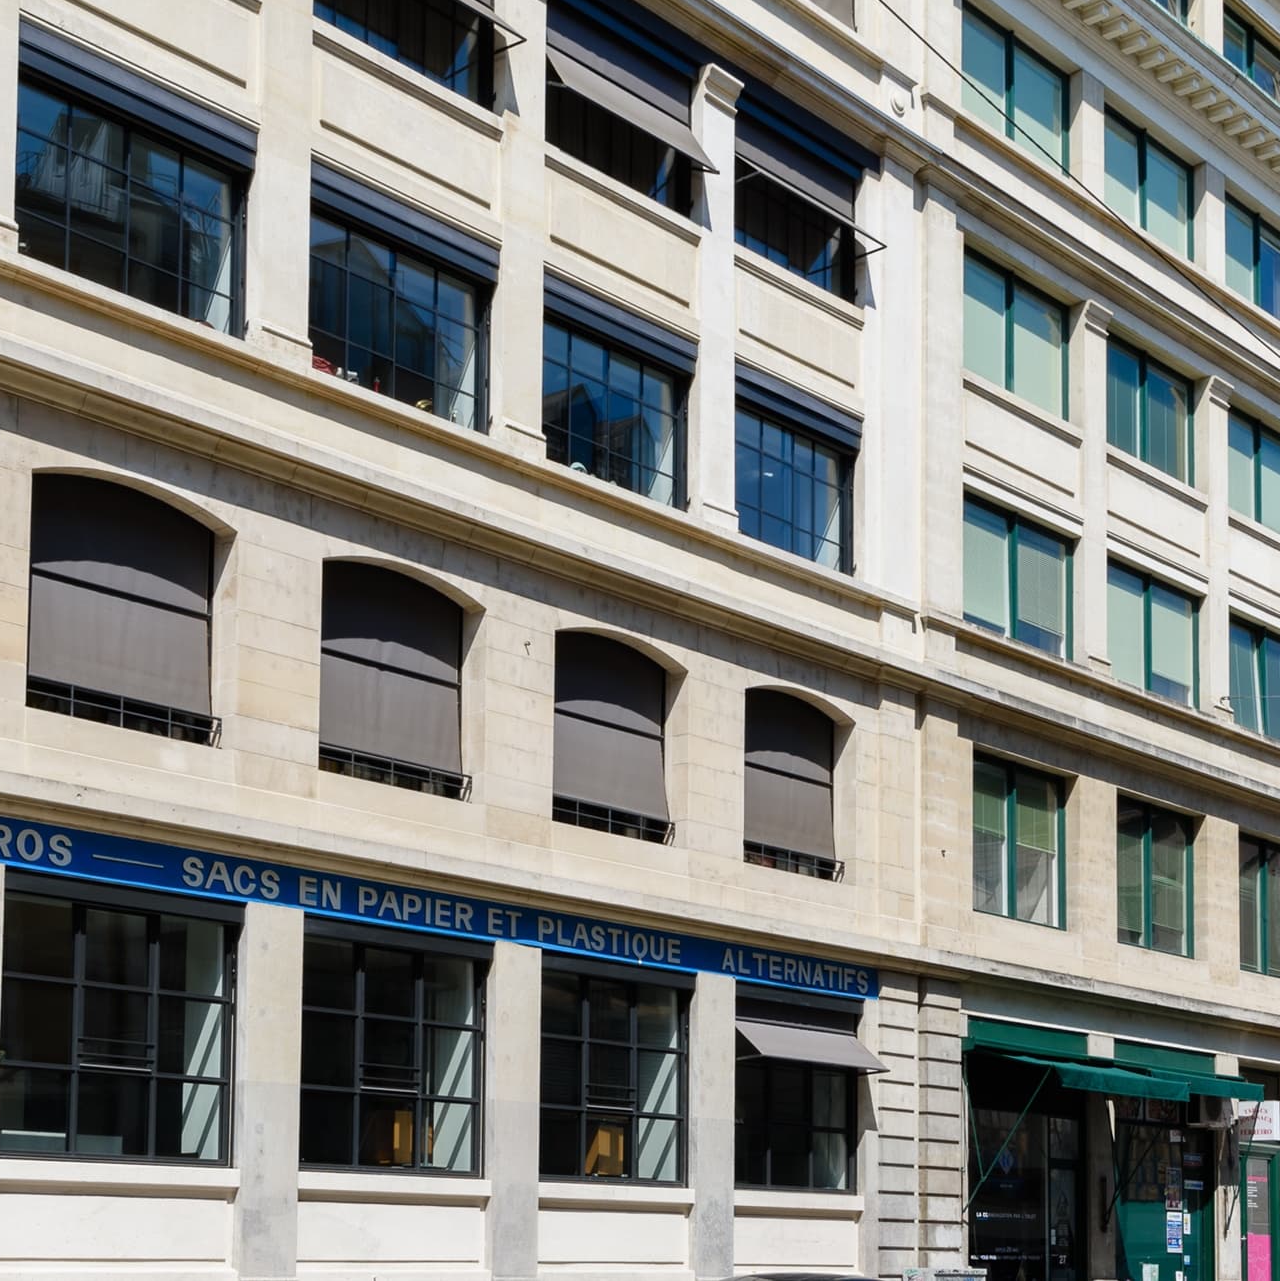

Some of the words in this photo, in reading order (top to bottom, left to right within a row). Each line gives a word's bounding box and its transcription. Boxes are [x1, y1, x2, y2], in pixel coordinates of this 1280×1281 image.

[182, 856, 281, 900] SACS
[298, 875, 342, 911] EN
[358, 887, 474, 931] PAPIER
[487, 907, 522, 938] ET
[537, 916, 682, 965] PLASTIQUE
[721, 947, 870, 995] ALTERNATIFS
